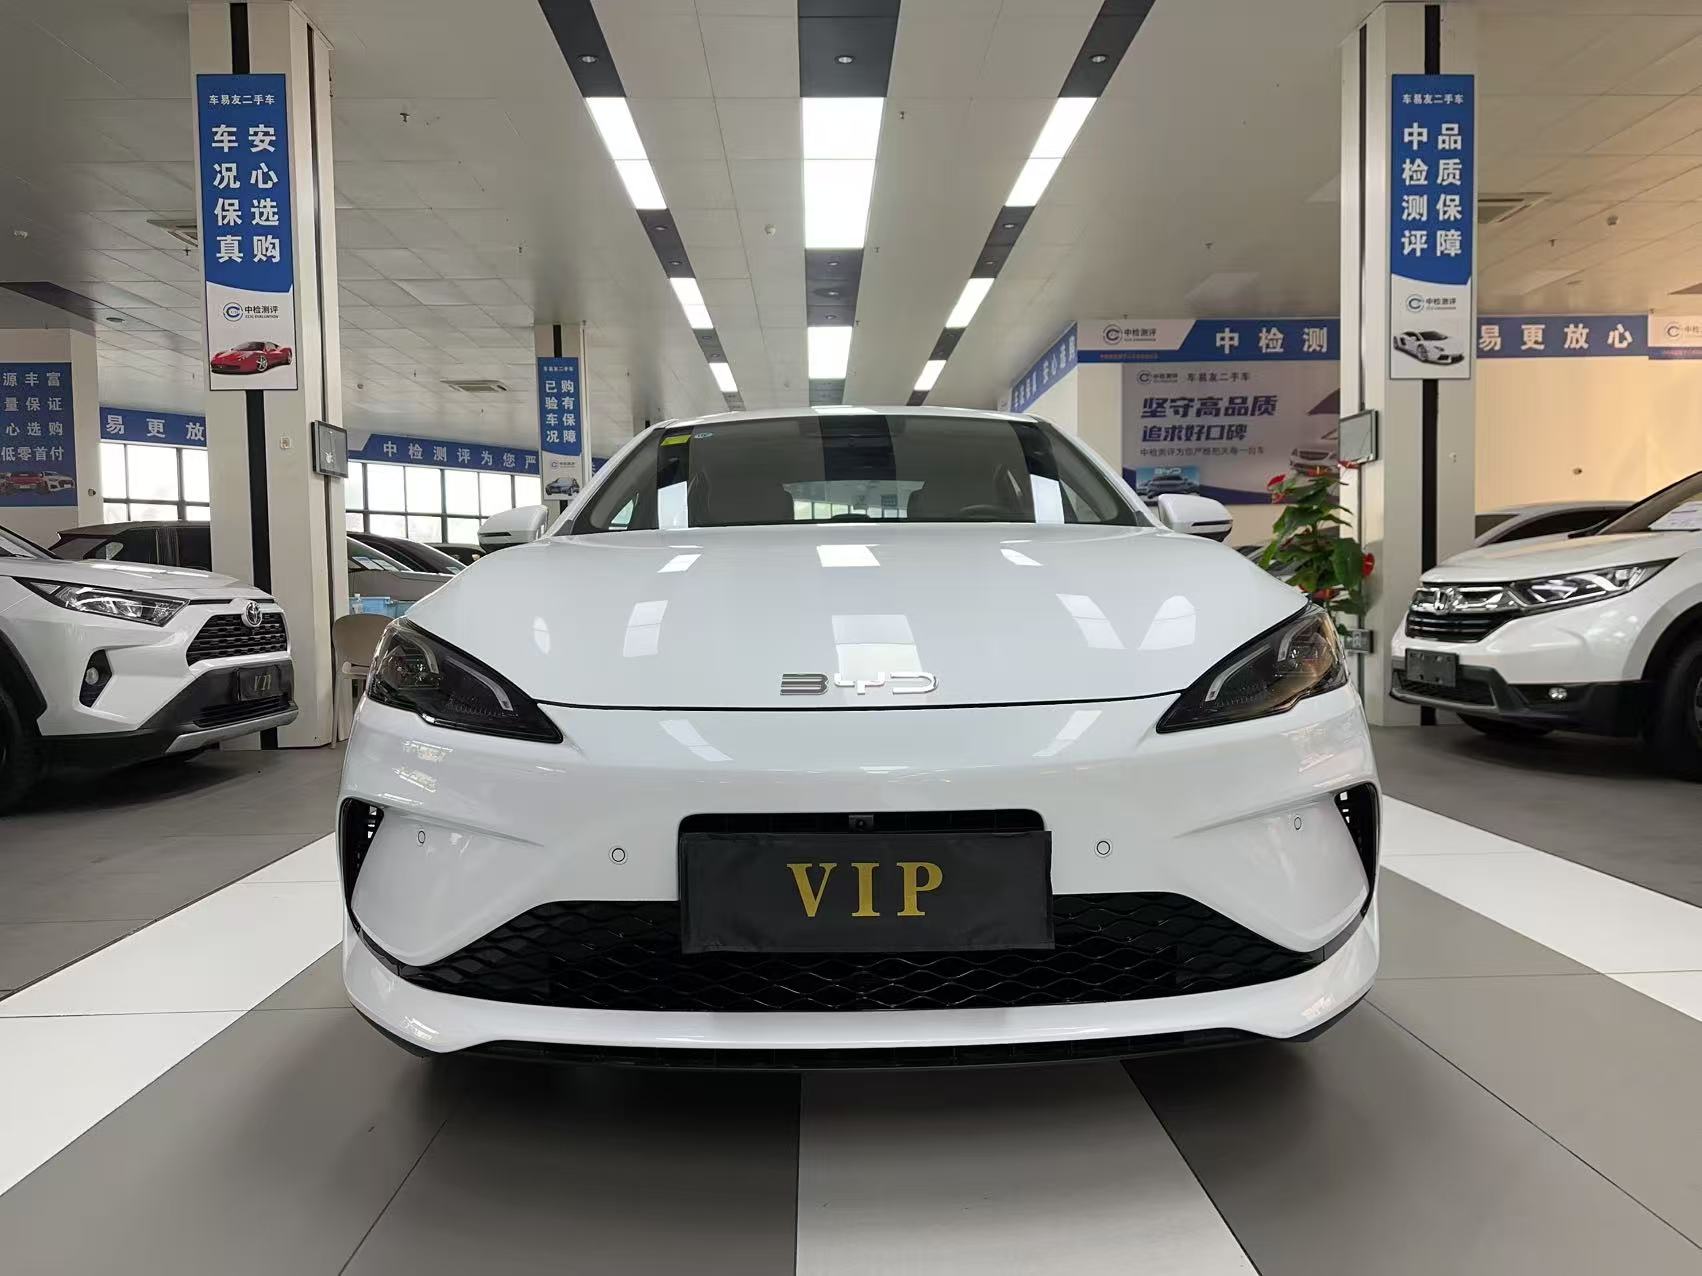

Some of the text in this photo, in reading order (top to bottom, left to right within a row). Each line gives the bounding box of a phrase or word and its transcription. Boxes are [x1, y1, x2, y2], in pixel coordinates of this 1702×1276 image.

[209, 94, 275, 106] 车易友二手车
[1402, 94, 1464, 105] 车易友二手车
[211, 124, 244, 263] 车况保真
[248, 124, 281, 263] 安心选购
[1401, 122, 1428, 257] 中检测评
[1435, 123, 1463, 257] 品质保障
[244, 305, 278, 314] 中检测评
[1215, 327, 1328, 354] 中检测
[1479, 323, 1634, 351] 易更放心
[2, 372, 61, 387] 源丰富
[3, 397, 63, 412] 量保证
[545, 380, 559, 443] 已验车况
[561, 380, 576, 443] 购有保障
[1140, 395, 1278, 419] 坚守高品质
[5, 421, 63, 437] 心选购
[105, 414, 205, 441] 易更放
[1141, 423, 1248, 443] 追求好口碑
[1, 446, 65, 462] 低零首付
[383, 441, 536, 469] 中检测评为您严
[780, 672, 939, 696] BYD
[786, 861, 944, 918] VIP
